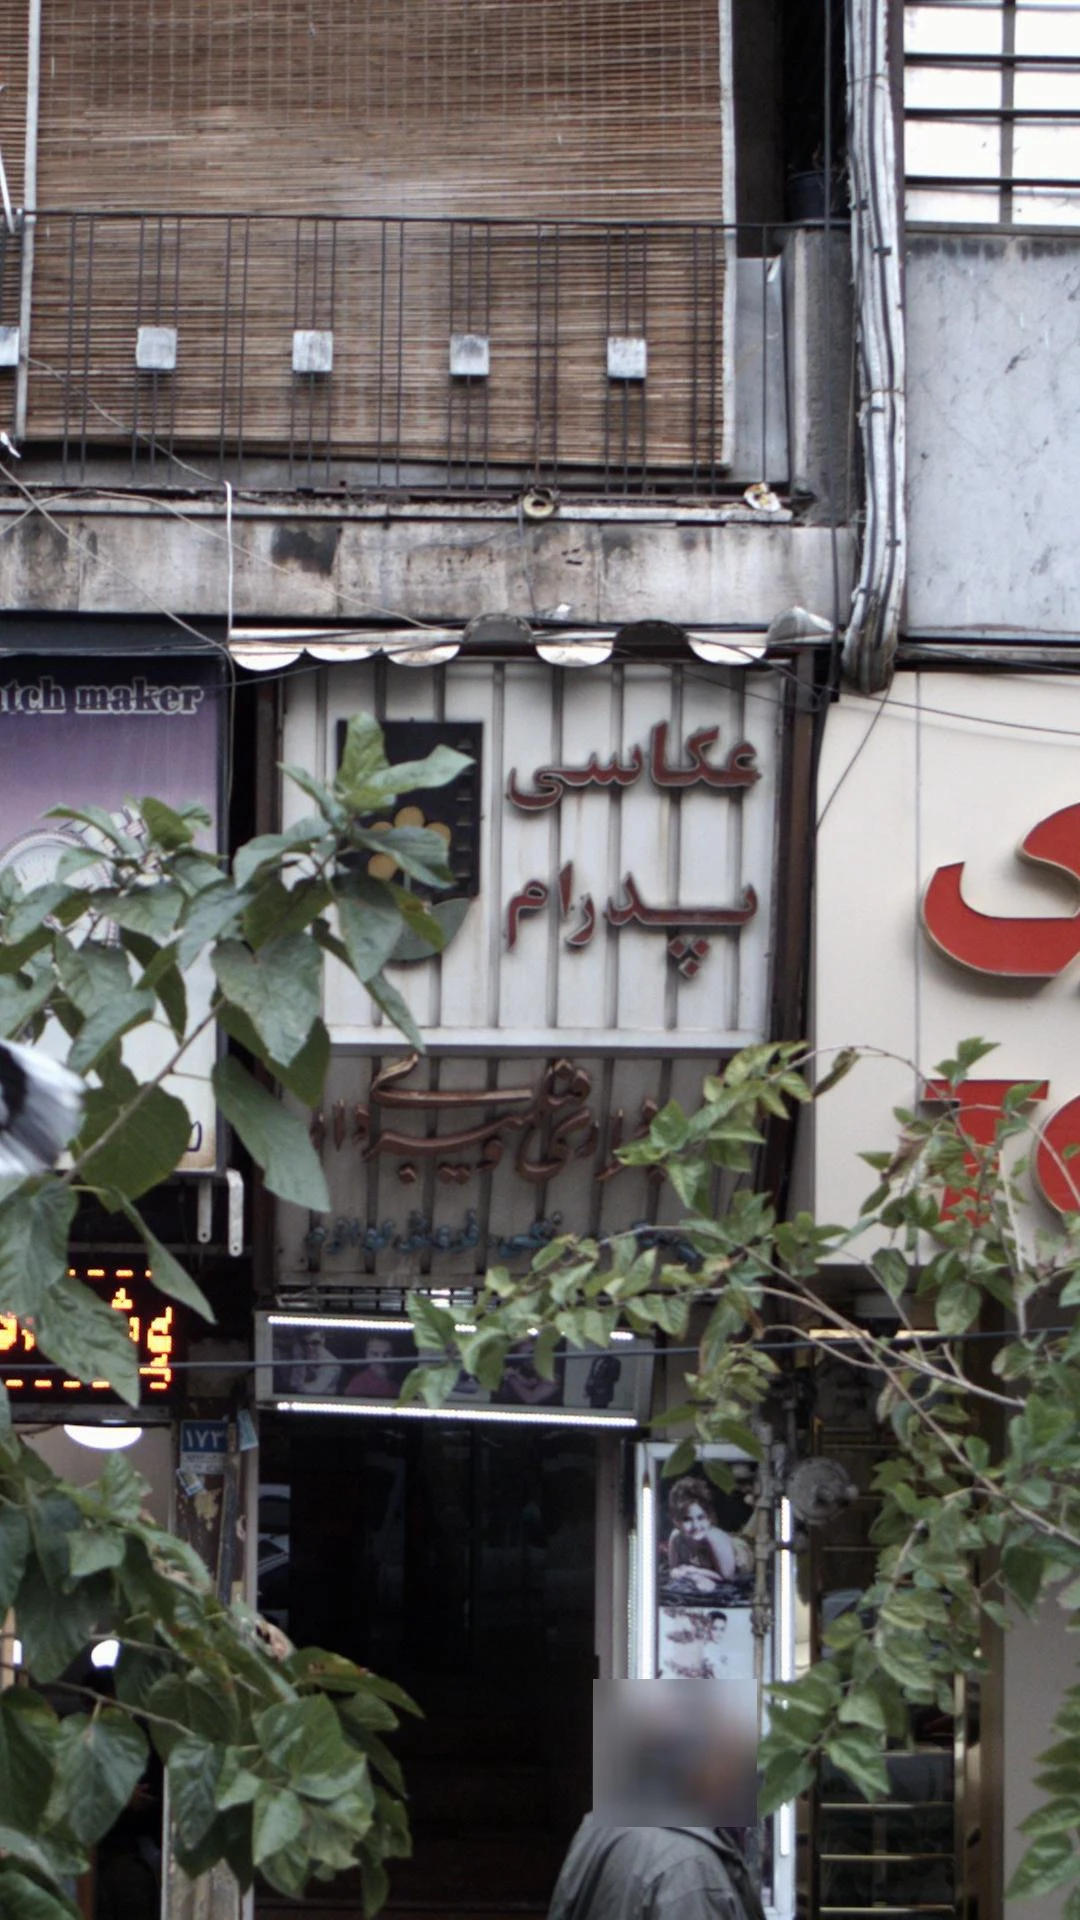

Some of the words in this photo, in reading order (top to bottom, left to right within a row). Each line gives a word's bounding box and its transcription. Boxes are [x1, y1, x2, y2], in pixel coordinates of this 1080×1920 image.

[0, 676, 66, 714] tch
[75, 677, 204, 715] maker
[506, 719, 762, 811] عکاسی
[504, 860, 760, 979] پدرام
